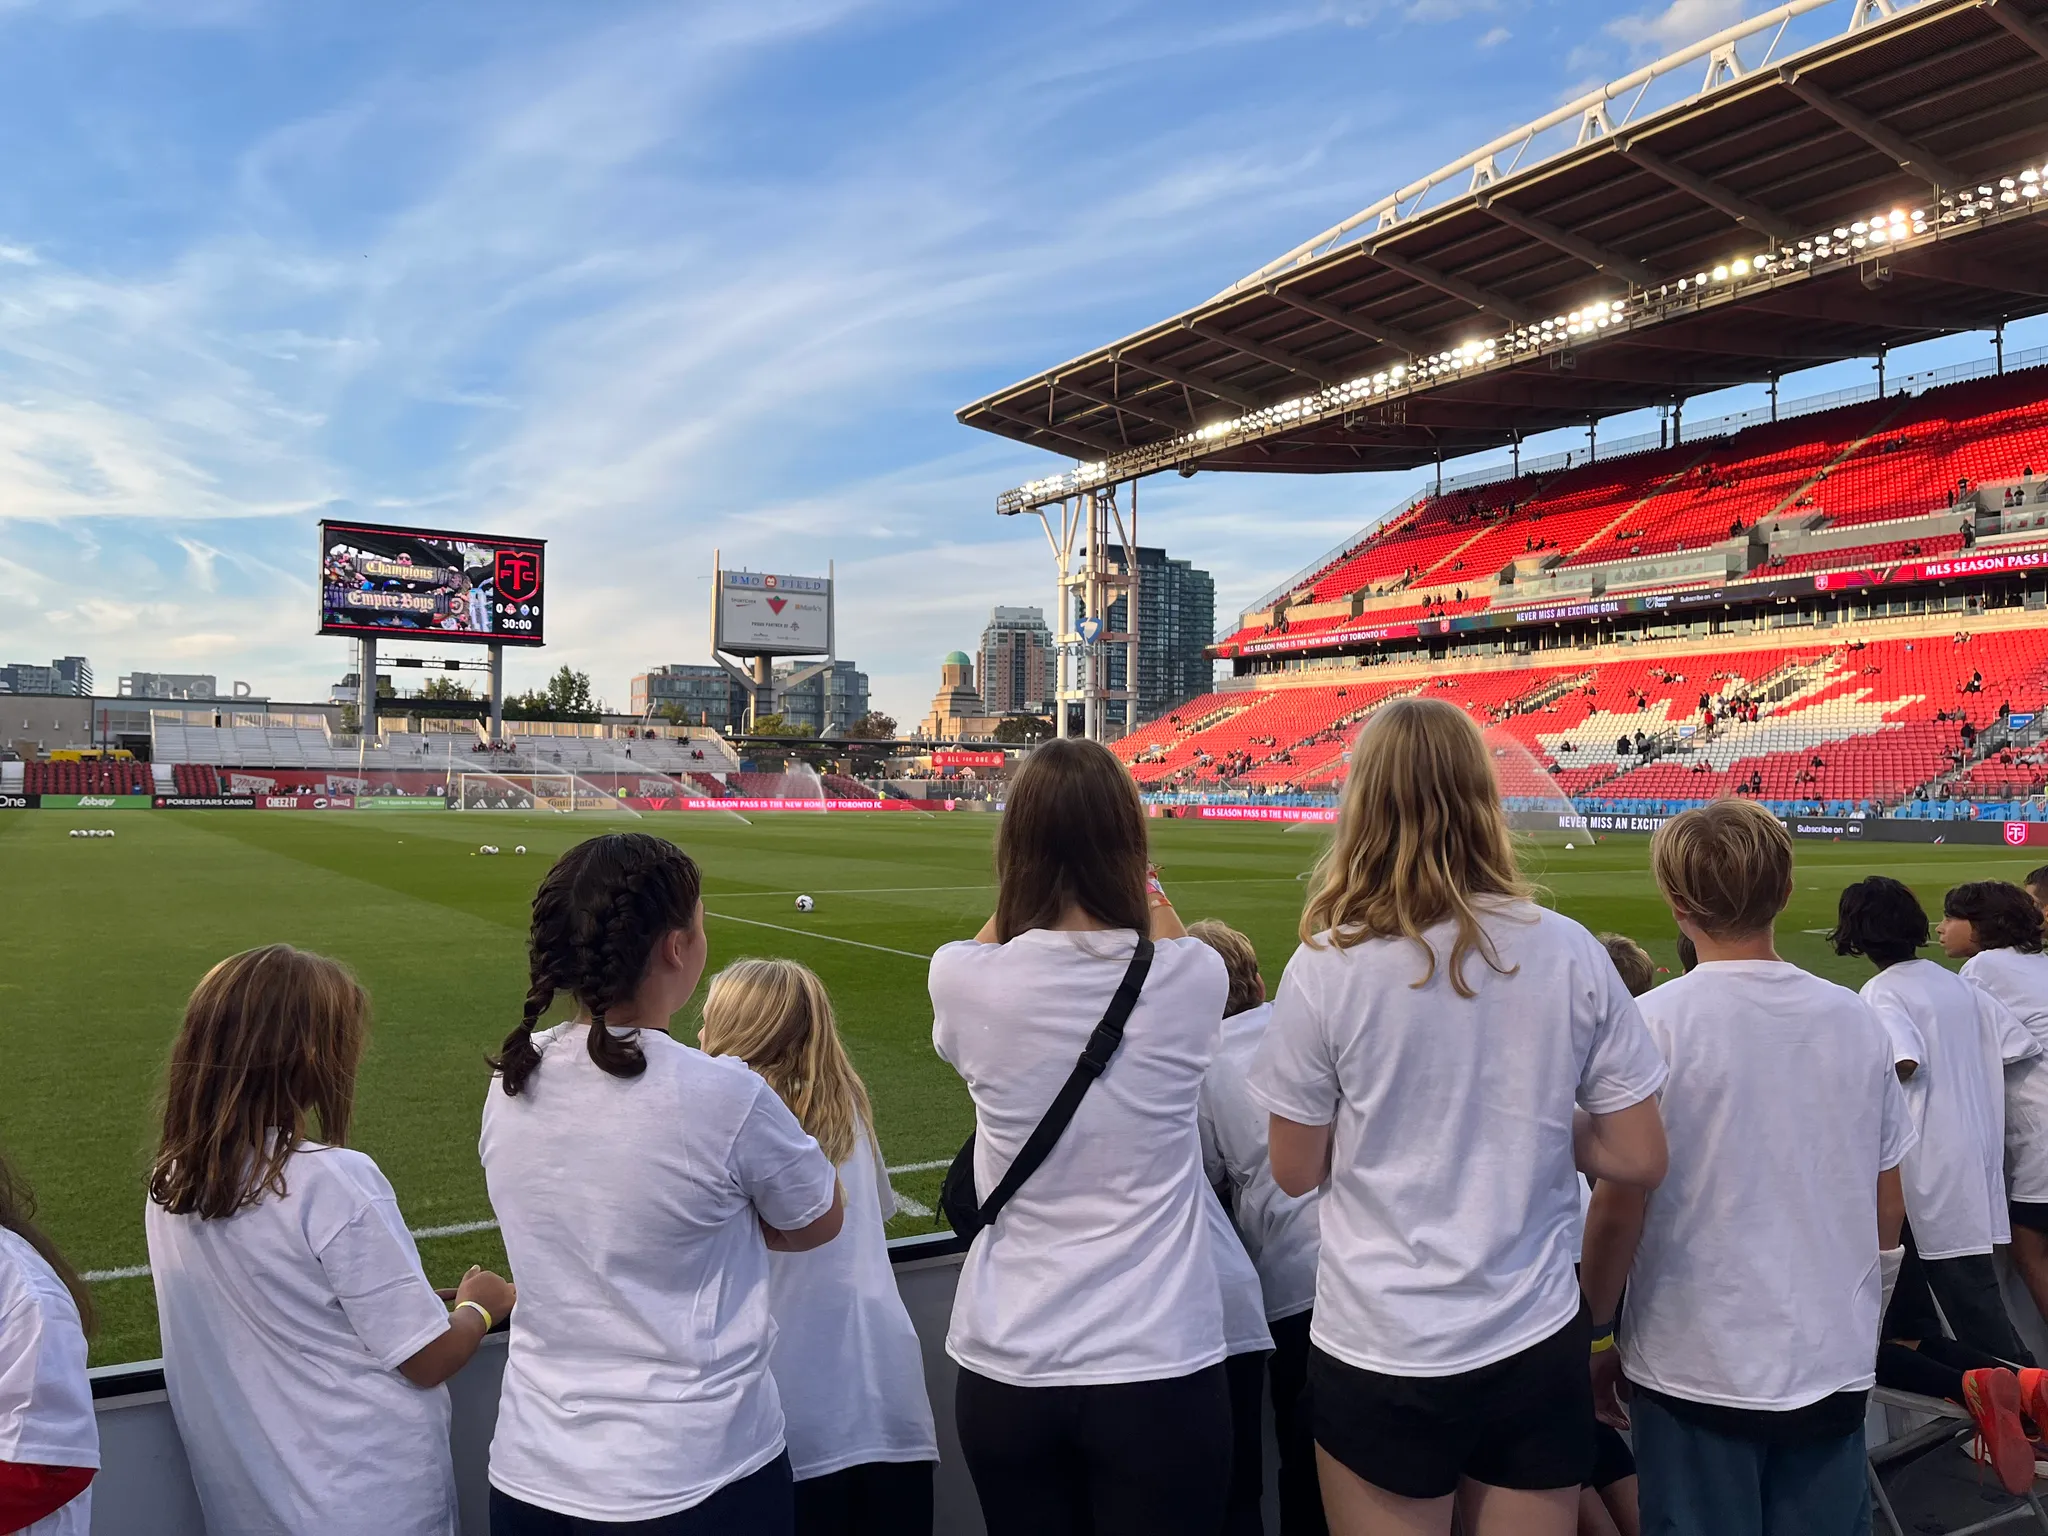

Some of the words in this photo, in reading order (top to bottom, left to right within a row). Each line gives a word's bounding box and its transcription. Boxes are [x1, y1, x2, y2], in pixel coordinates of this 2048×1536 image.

[366, 561, 434, 580] Champions
[1926, 563, 1950, 576] MLS
[1954, 557, 2004, 573] SEASON
[2008, 553, 2040, 567] PASS
[731, 575, 760, 586] BMO
[781, 579, 821, 590] FIELD
[348, 591, 399, 610] Empire
[400, 594, 435, 613] Boys
[496, 603, 504, 614] 0
[532, 605, 540, 616] 0
[1516, 611, 1536, 622] NEVER
[1539, 609, 1555, 620] MISS
[1556, 608, 1566, 618] AN
[1567, 604, 1598, 617] EXCITING
[1600, 602, 1619, 613] GOAL
[502, 619, 532, 630] 30:00
[1243, 644, 1254, 652] MLS
[1254, 642, 1275, 652] SEASON
[1276, 641, 1289, 649] PASS
[1290, 640, 1296, 648] IS
[1296, 639, 1307, 647] THE
[1308, 638, 1321, 646] NEW
[1322, 636, 1339, 645] HOME
[1340, 634, 1349, 642] OF
[1349, 631, 1378, 641] TORONTO
[947, 755, 959, 763] ALL
[0, 795, 26, 807] One
[166, 798, 222, 806] POKERSTARS
[548, 799, 596, 807] Contiental
[688, 800, 705, 808] MLS
[706, 800, 738, 808] SEASON
[739, 800, 758, 808] PASS
[827, 801, 837, 809] OF
[838, 801, 872, 809] TORONTO
[874, 801, 883, 809] FC
[1202, 808, 1216, 817] MLS
[1216, 808, 1243, 817] SEASON
[1243, 809, 1260, 818] PASS
[1260, 810, 1268, 818] IS
[1269, 810, 1282, 819] THE
[1283, 810, 1300, 819] NEW
[1301, 811, 1323, 820] HOME
[1324, 811, 1334, 820] OF
[1559, 815, 1588, 828] NEVER
[1590, 816, 1613, 829] MISS
[1615, 817, 1628, 829] AN
[1631, 817, 1667, 831] EXCITI
[1797, 824, 1833, 834] Subscribe
[1833, 826, 1843, 834] on
